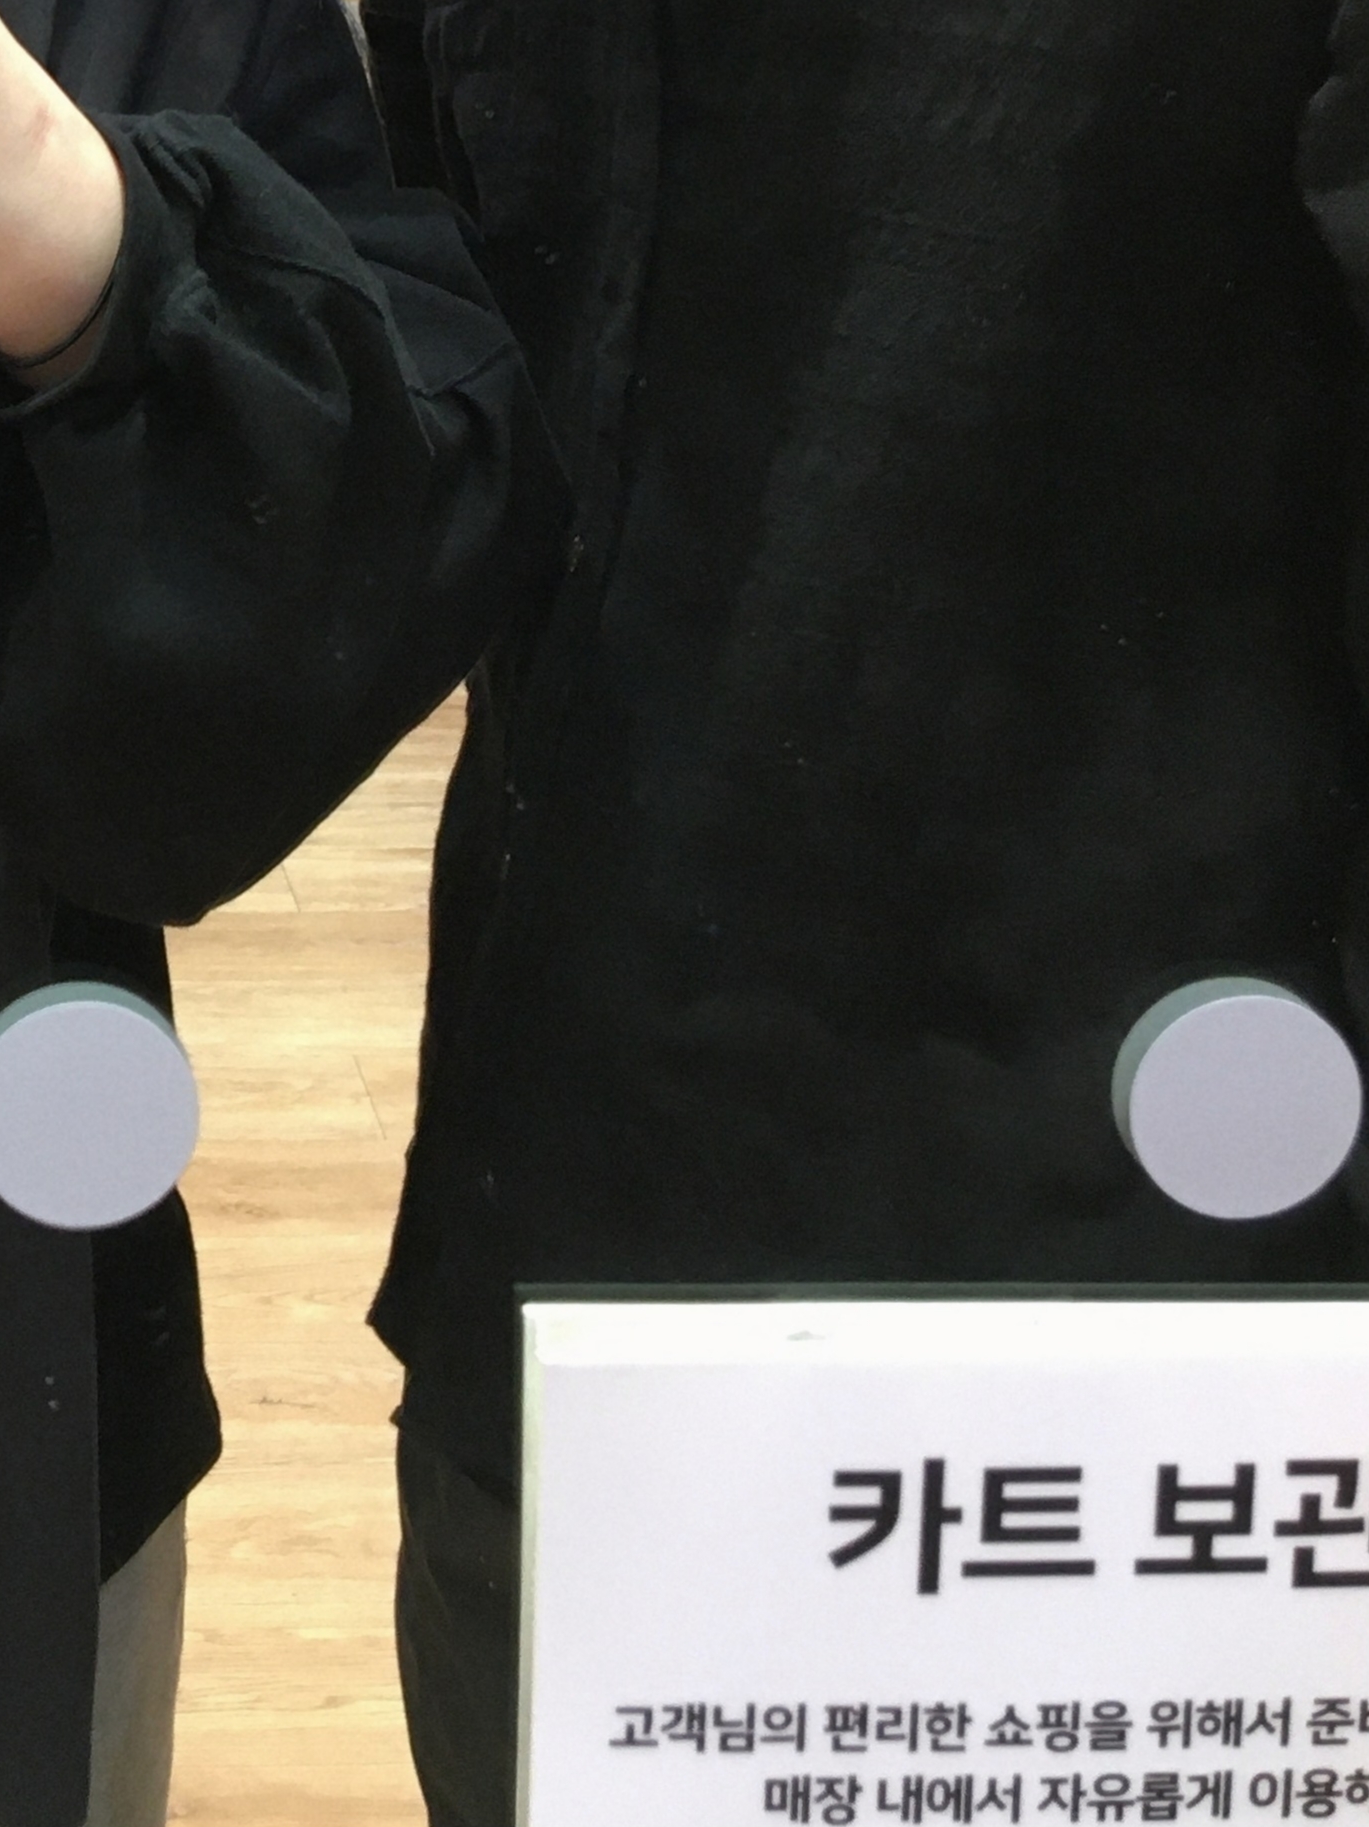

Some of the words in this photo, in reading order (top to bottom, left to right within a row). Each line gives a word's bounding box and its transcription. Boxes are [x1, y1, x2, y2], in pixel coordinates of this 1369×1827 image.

[827, 1456, 1097, 1595] 카트
[609, 1702, 806, 1753] 고객님의
[824, 1702, 972, 1753] 편리한
[984, 1700, 1133, 1752] 쇼핑을
[1146, 1697, 1292, 1750] 위해서
[764, 1774, 863, 1825] 매장
[877, 1774, 1022, 1825] 내에서
[1038, 1772, 1234, 1824] 자유롭게
